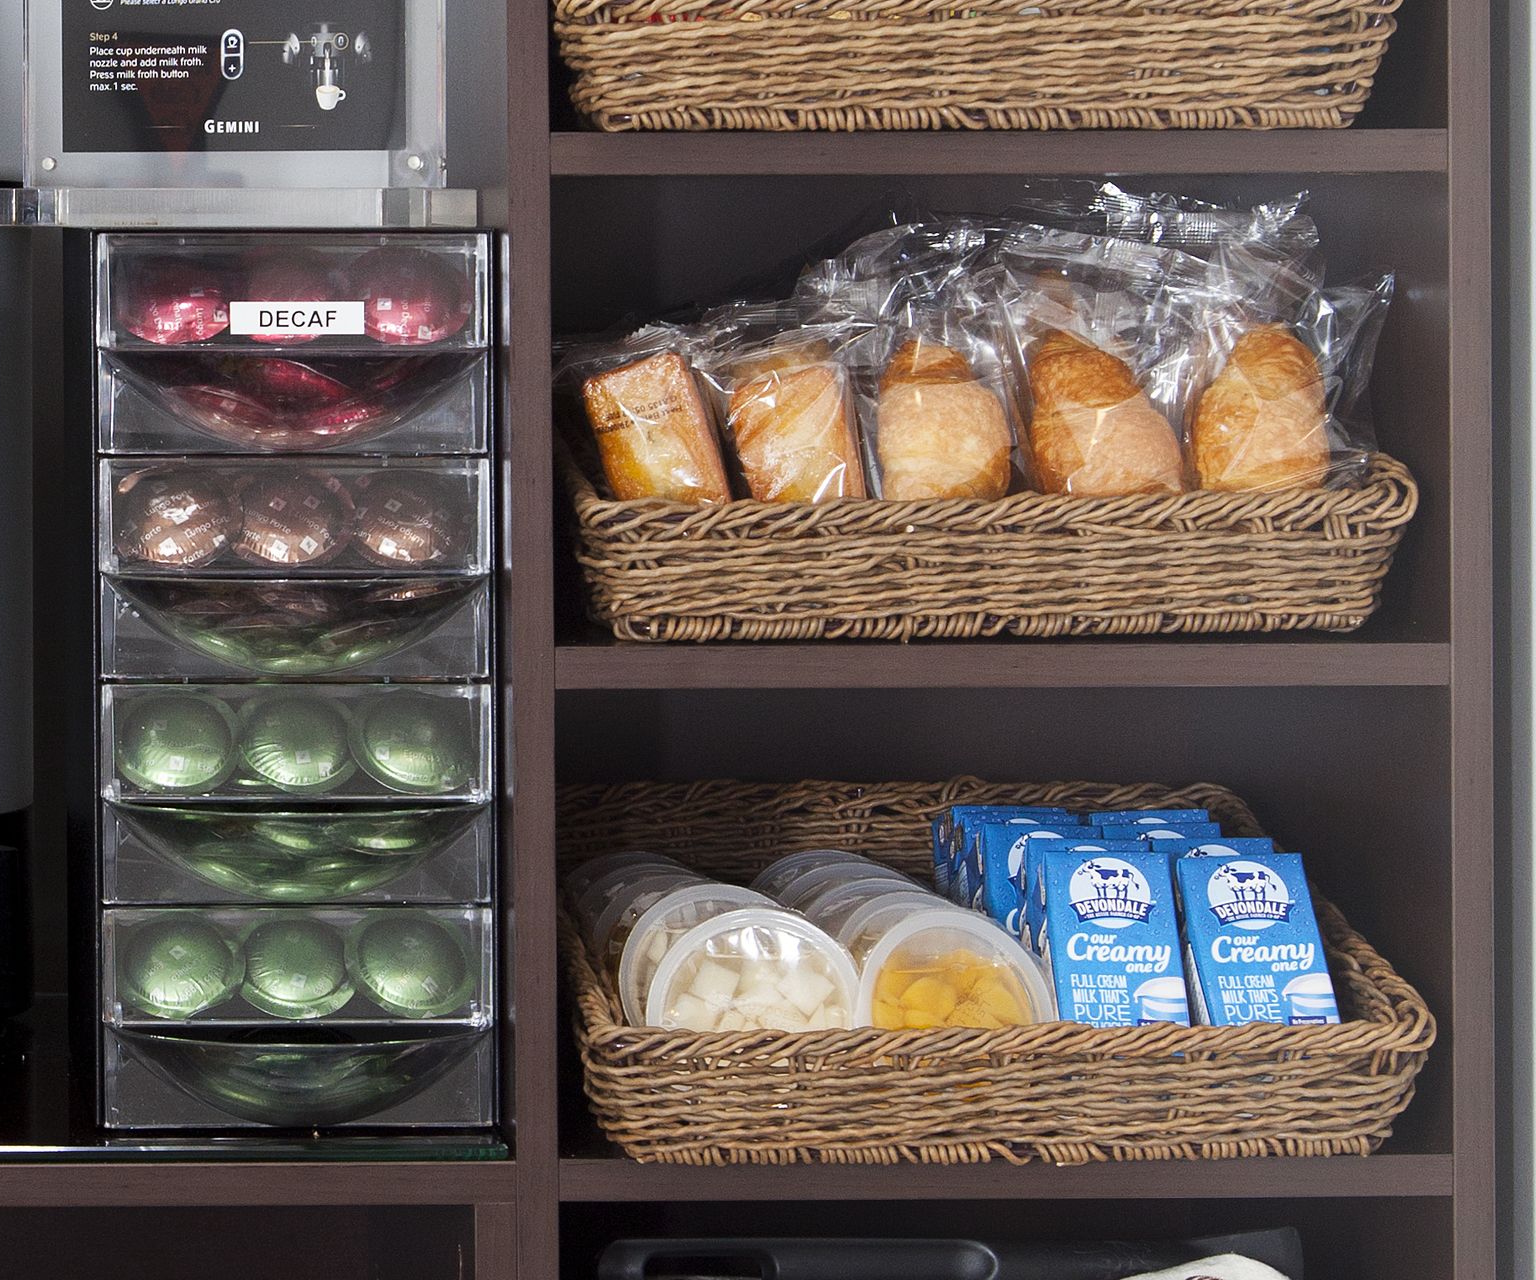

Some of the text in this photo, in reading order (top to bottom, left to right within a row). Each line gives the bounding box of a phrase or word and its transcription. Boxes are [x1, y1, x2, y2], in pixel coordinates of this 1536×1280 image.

[90, 32, 118, 42] Step 4
[90, 45, 207, 57] Place cup underneath milk
[90, 58, 204, 67] nozzle and add milk froth.
[90, 69, 189, 79] Press milk froth button
[90, 82, 138, 91] max. 1 sec.
[204, 119, 259, 133] GEMINI
[259, 310, 338, 328] DECAF
[1076, 899, 1148, 917] DEVONDALE
[1216, 902, 1287, 919] DEVONDALE
[1090, 933, 1117, 945] our
[1234, 935, 1260, 945] our
[1067, 933, 1171, 972] Creamy
[1211, 935, 1314, 970] Creamy
[1125, 962, 1152, 973] one
[1271, 961, 1298, 972] one
[1071, 974, 1127, 988] FULL CREAM
[1218, 975, 1275, 988] FULL CREAM
[1073, 989, 1130, 1004] MILK THAT'S
[1221, 989, 1279, 1004] MILK THAT'S
[1074, 1004, 1131, 1021] PURE
[1225, 1004, 1283, 1020] PURE
